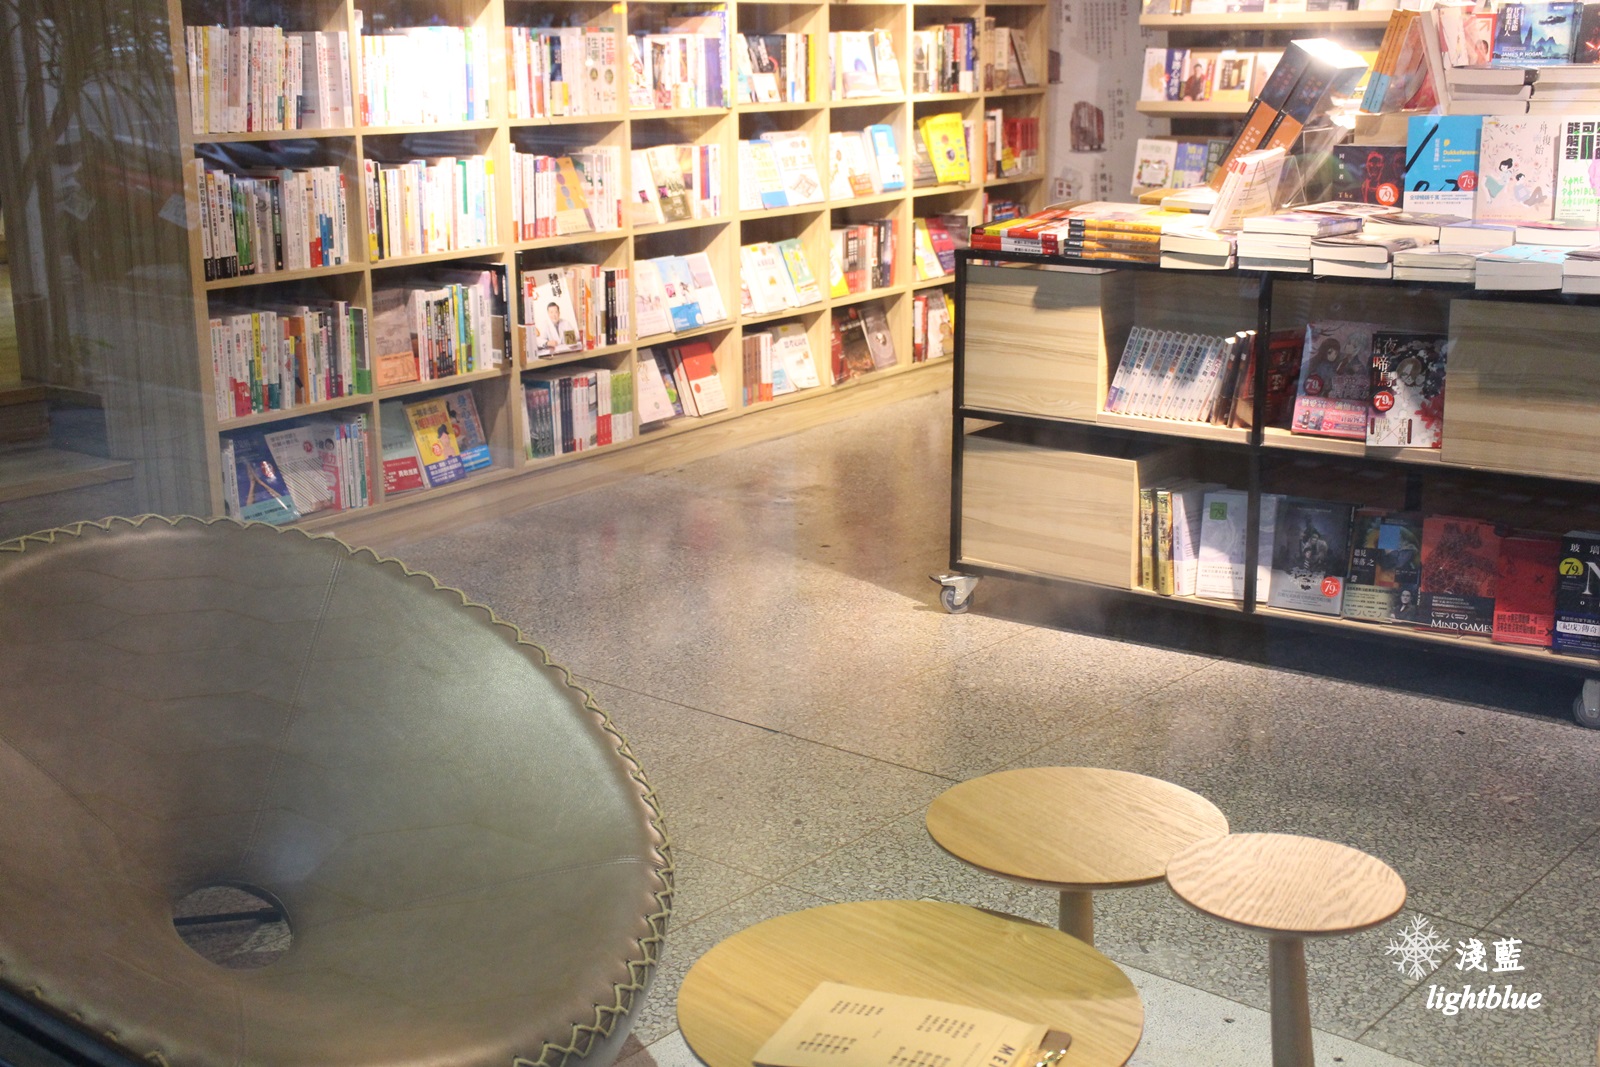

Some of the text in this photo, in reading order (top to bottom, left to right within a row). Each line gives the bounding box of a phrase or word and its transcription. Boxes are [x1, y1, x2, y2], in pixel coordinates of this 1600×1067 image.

[1338, 191, 1354, 199] The
[1324, 580, 1338, 594] 79
[1430, 619, 1460, 630] MIND
